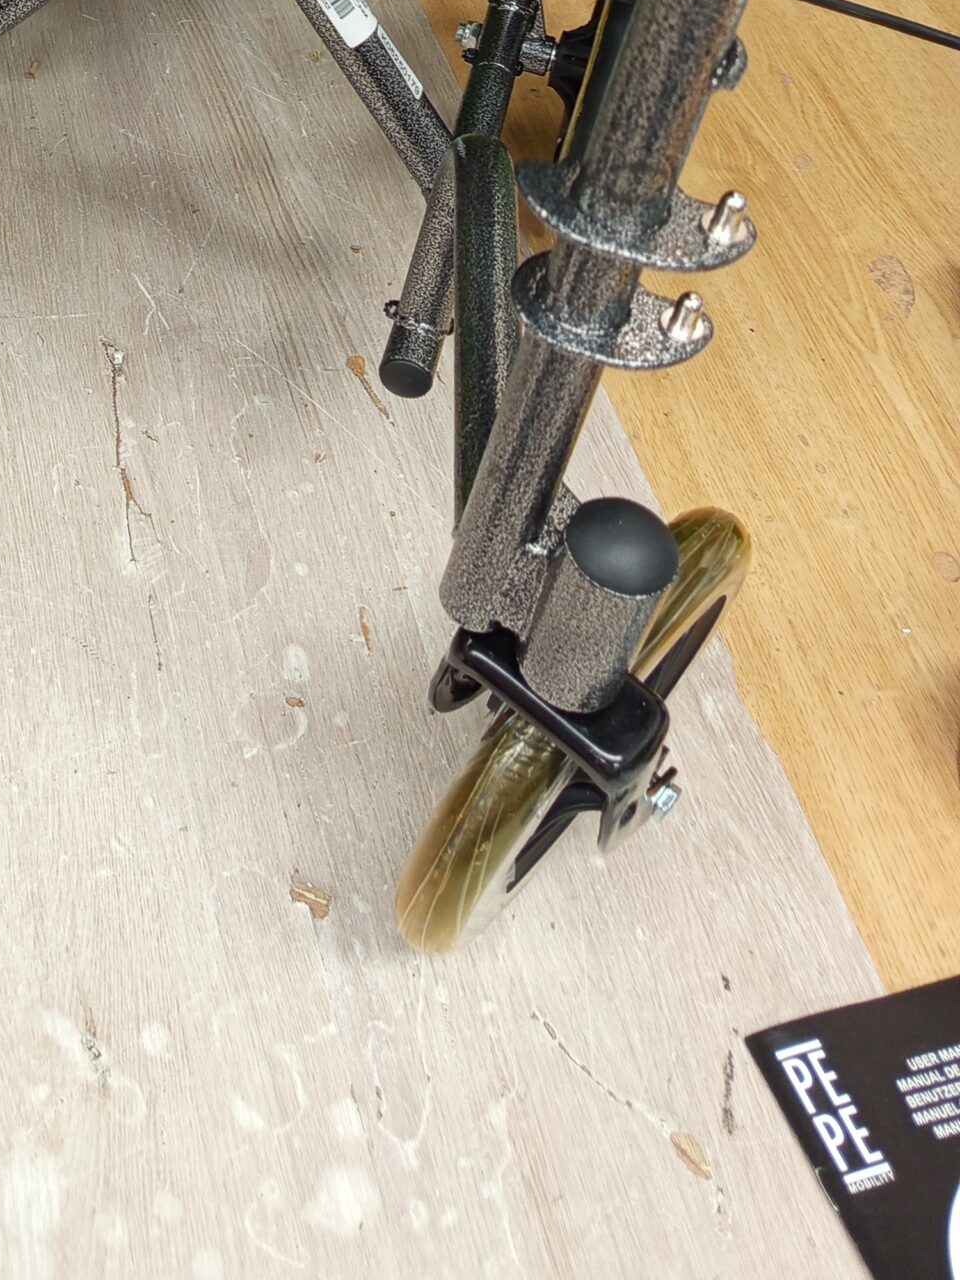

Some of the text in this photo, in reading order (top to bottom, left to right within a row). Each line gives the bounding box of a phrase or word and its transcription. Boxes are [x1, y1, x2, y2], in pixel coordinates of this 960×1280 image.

[906, 1052, 940, 1072] USER
[896, 1069, 946, 1093] MANUAL
[912, 1102, 960, 1127] MANUEL
[847, 1171, 895, 1195] MOBILITY
